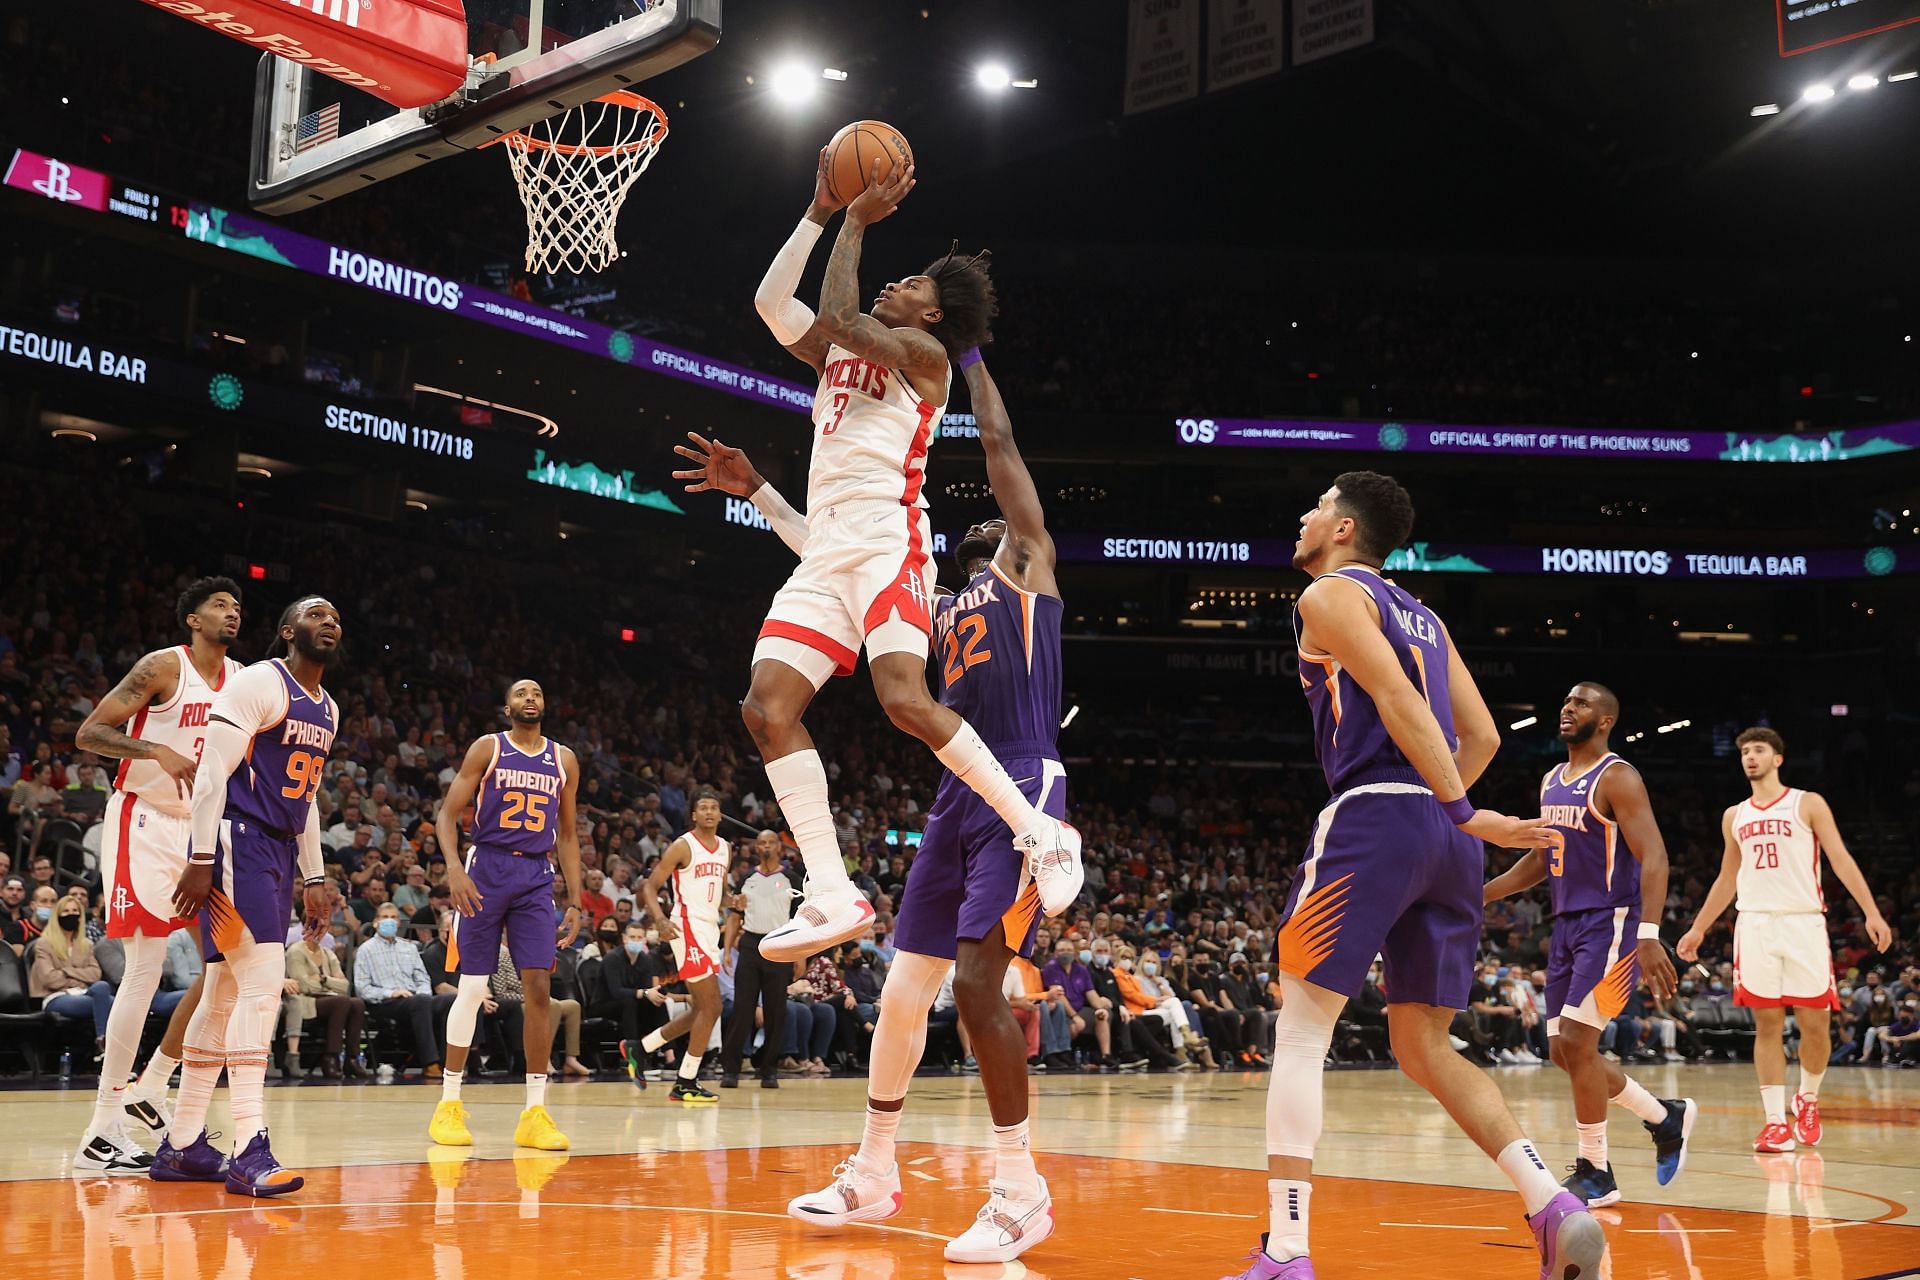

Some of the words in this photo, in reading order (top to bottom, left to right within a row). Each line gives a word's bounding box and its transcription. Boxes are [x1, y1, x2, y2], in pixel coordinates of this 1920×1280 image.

[248, 33, 380, 87] Farm
[109, 198, 148, 220] TIMEOUTS
[124, 188, 150, 205] FOULS
[328, 247, 460, 310] HORNITOS
[0, 325, 94, 372] TEQUILA
[99, 350, 147, 384] BAR
[652, 349, 702, 377] OFFICIAL
[703, 364, 739, 387] SPIRIT
[740, 376, 756, 391] OF
[757, 380, 779, 399] THE
[779, 387, 814, 409] PHOEN
[823, 393, 849, 436] 3
[324, 404, 408, 445] SECTION
[412, 426, 474, 461] 117/118
[942, 425, 980, 438] DEFEN
[1176, 418, 1217, 443] OS
[1429, 431, 1490, 447] OFFICIAL
[1492, 432, 1537, 448] SPIRIT
[1539, 434, 1558, 449] OF
[1560, 434, 1587, 450] THE
[1590, 435, 1650, 451] PHOENIX
[1652, 437, 1691, 452] SUNS
[1103, 538, 1182, 559] SECTION
[1186, 541, 1250, 562] 117/118
[1542, 548, 1669, 576] HORNITOS
[1686, 554, 1763, 576] TEQUILA
[1766, 555, 1808, 577] BAR
[943, 613, 992, 688] 22
[178, 703, 212, 728] ROC
[281, 751, 325, 803] 99
[495, 768, 560, 799] PHOENIX
[499, 791, 549, 833] 25
[1738, 819, 1792, 842] ROCKETS
[1550, 831, 1565, 877] 3
[1753, 842, 1779, 870] 28
[694, 862, 728, 880] ROCKET
[707, 882, 715, 903] 0
